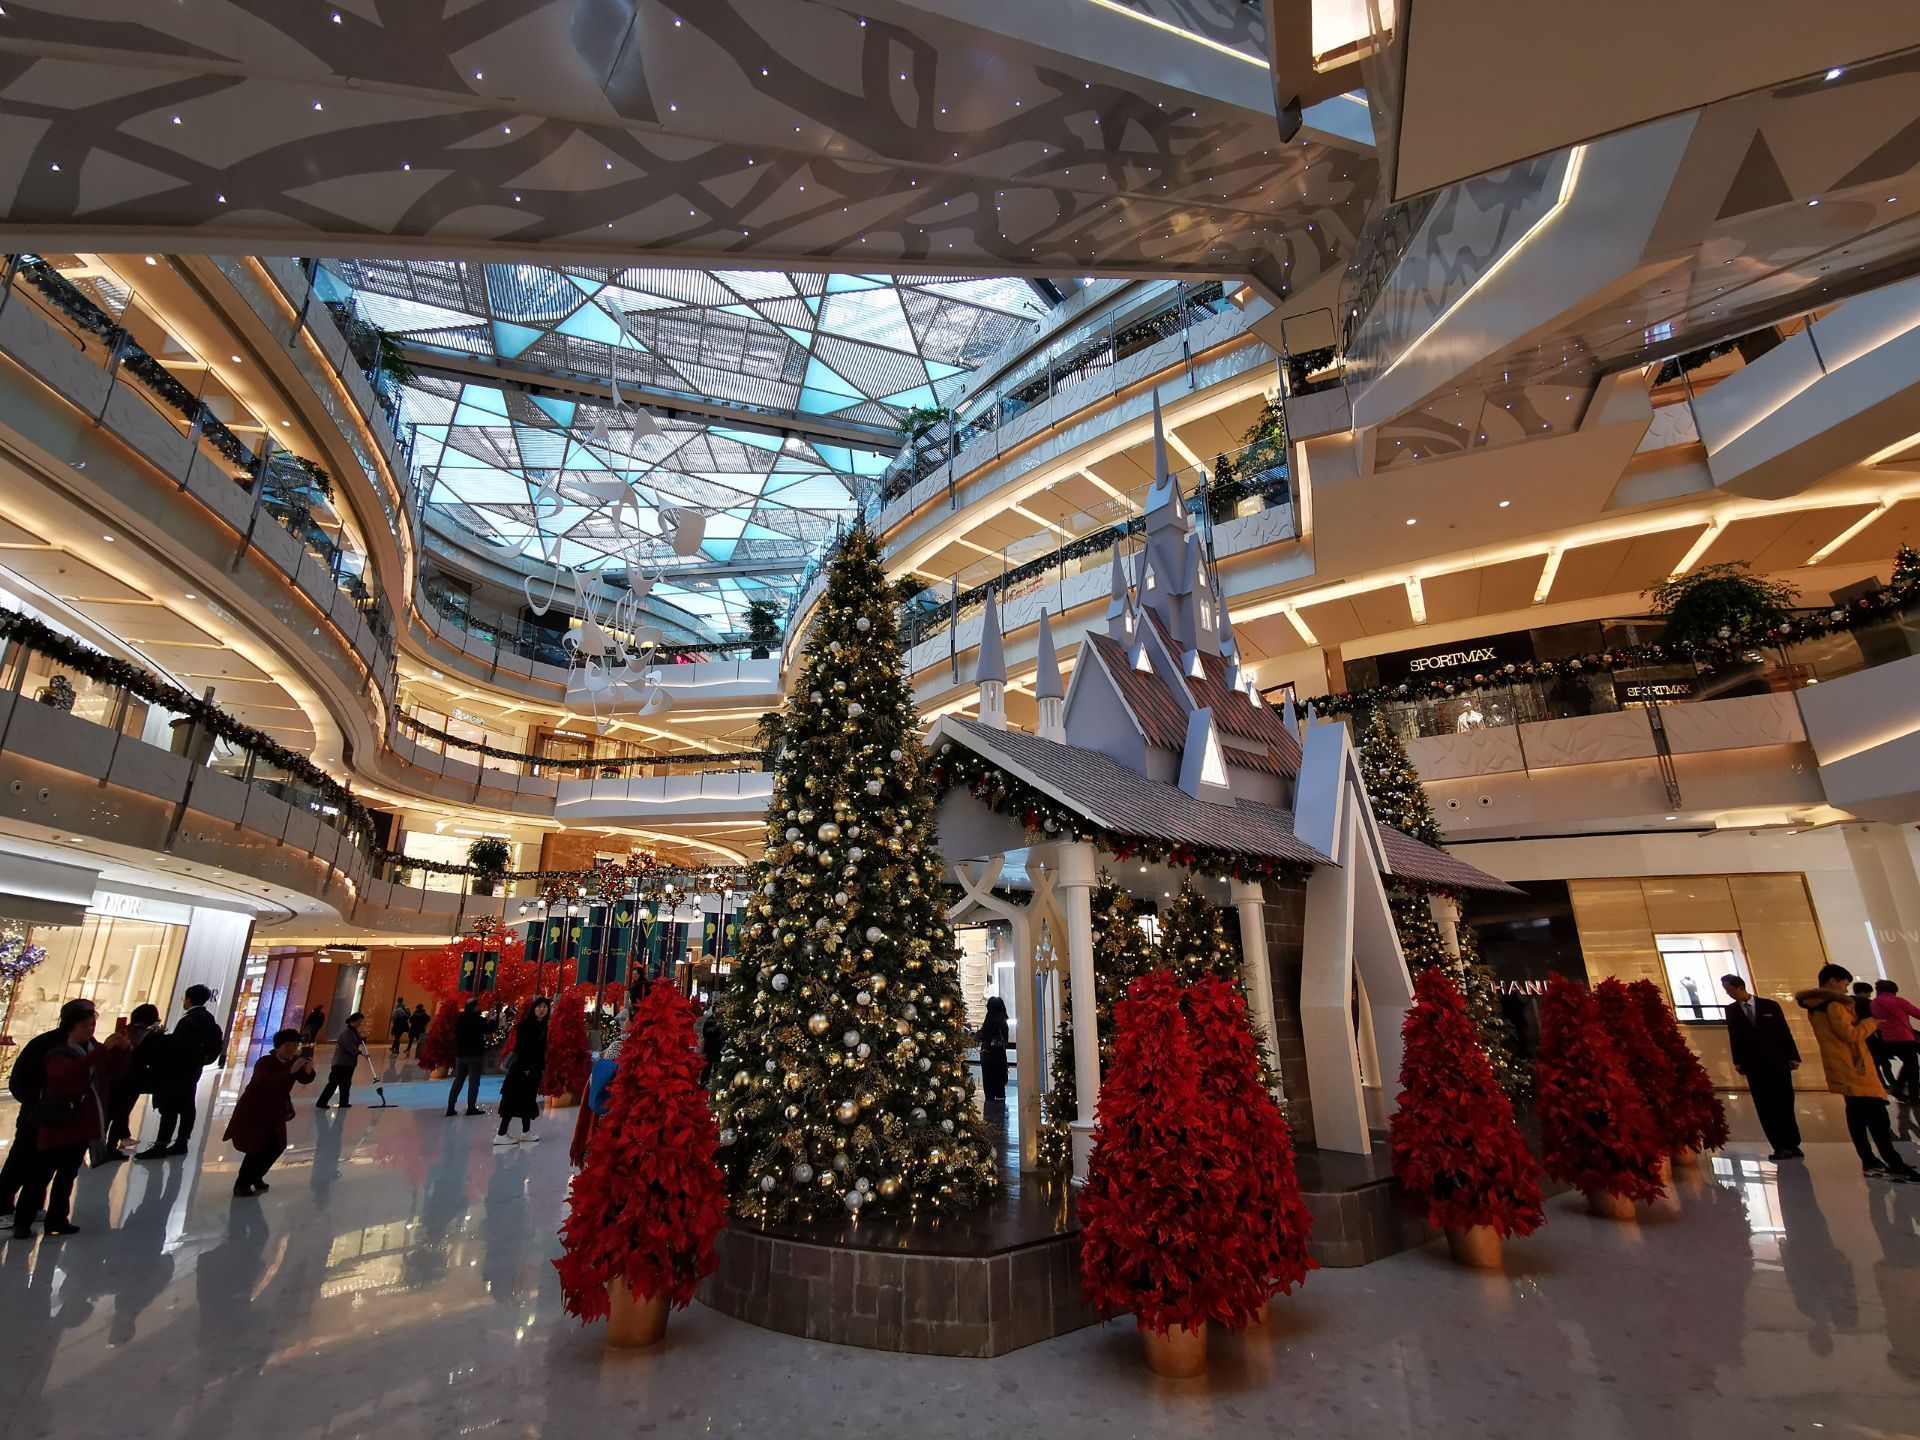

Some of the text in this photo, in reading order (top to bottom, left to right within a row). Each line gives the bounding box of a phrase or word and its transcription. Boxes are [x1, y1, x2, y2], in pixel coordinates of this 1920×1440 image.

[1410, 647, 1497, 672] SPORTMAX
[1626, 684, 1692, 697] SPORTMAX
[104, 894, 143, 915] DIOR
